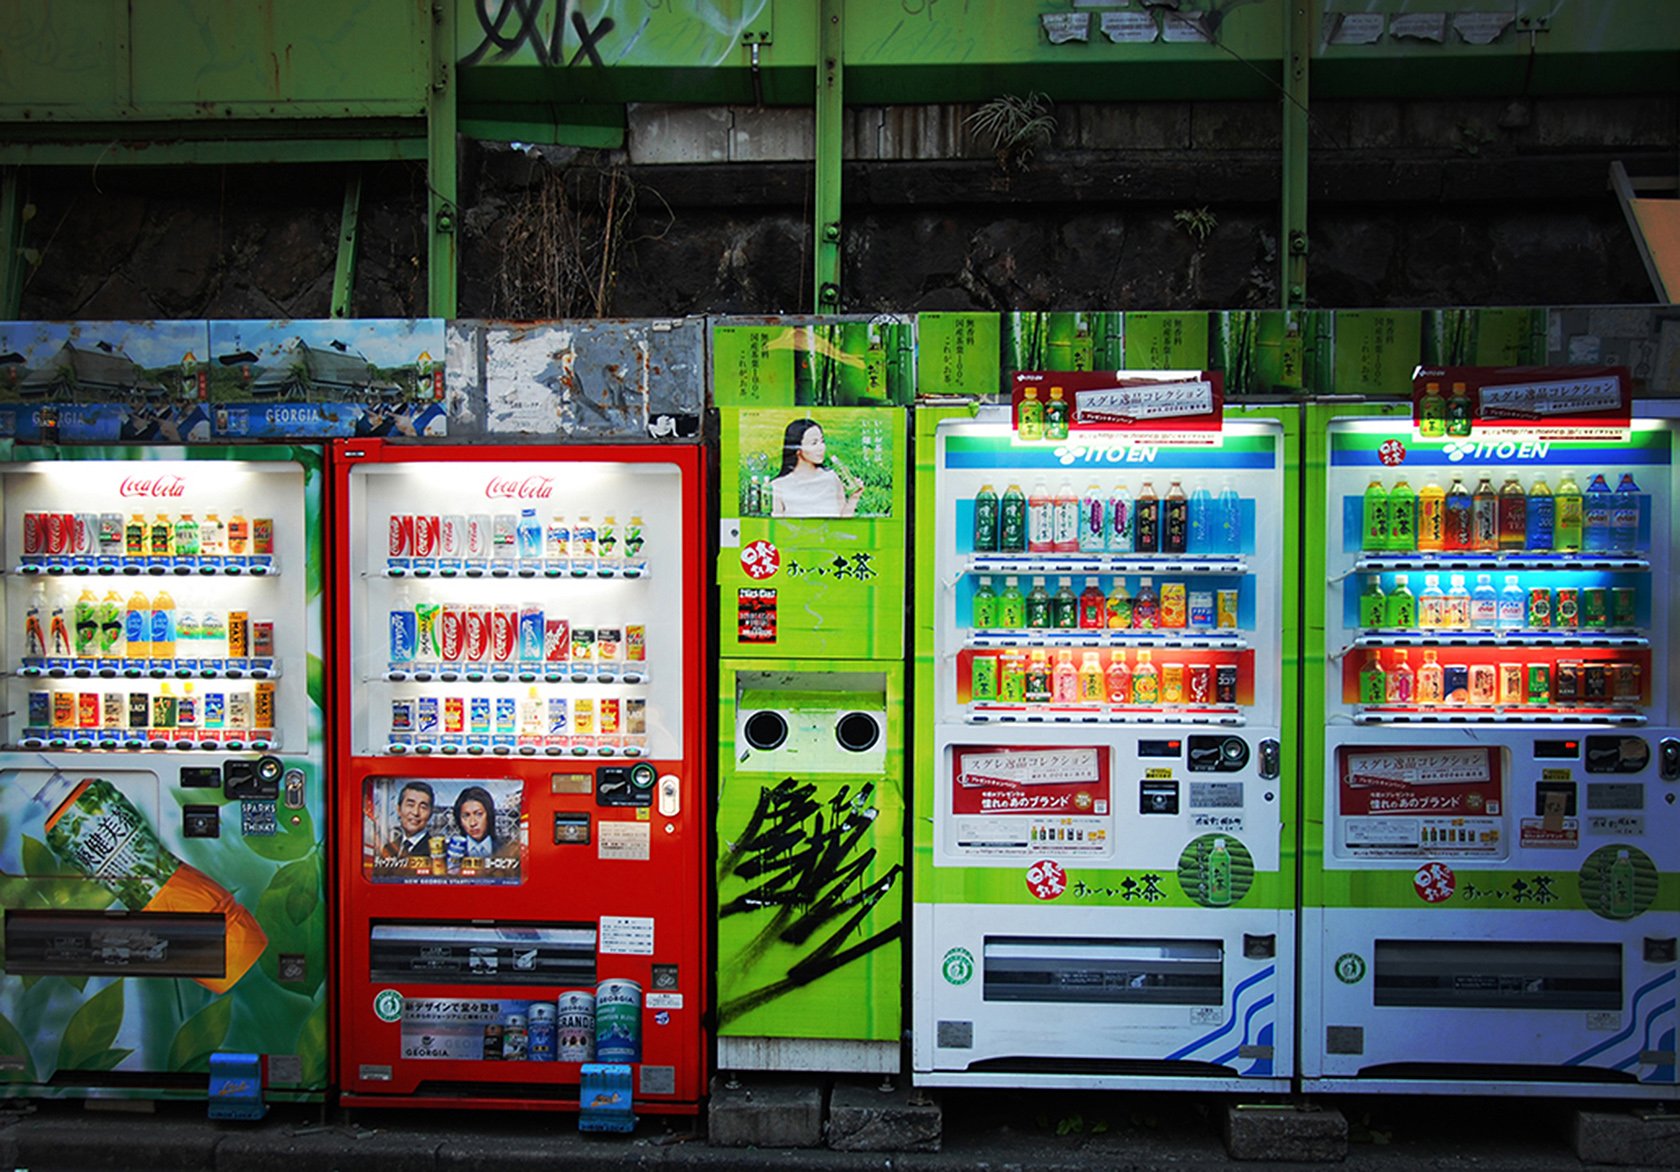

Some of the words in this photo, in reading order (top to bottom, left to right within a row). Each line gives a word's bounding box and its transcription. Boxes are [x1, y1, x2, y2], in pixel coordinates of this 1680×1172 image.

[266, 409, 319, 426] GEORGIA
[1085, 446, 1126, 464] ITO
[1127, 446, 1159, 464] EN
[1473, 443, 1516, 460] ITO
[1517, 443, 1549, 460] EN
[404, 1049, 448, 1057] GEORGIA
